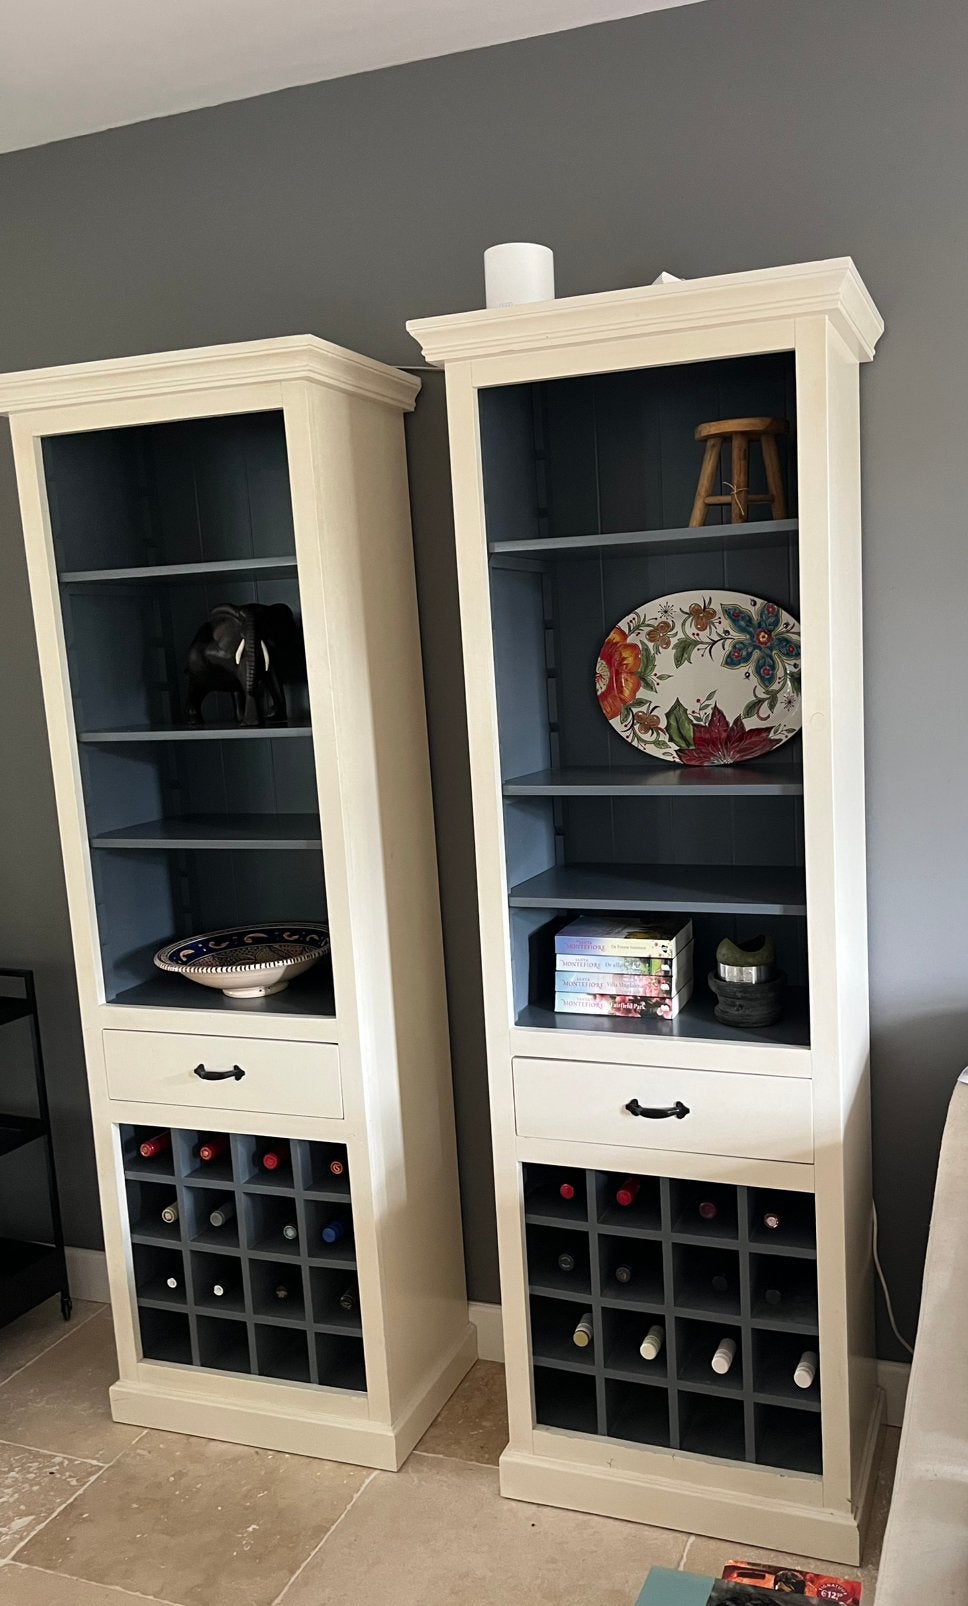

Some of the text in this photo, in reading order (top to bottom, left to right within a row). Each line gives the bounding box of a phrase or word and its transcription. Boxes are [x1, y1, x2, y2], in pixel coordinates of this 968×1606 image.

[565, 942, 606, 952] MONTEFIORE
[560, 960, 601, 970] MONTEFIORE
[562, 979, 603, 990] MONTEFIORE
[561, 999, 604, 1010] MONTEFIORE
[634, 1001, 646, 1010] Park
